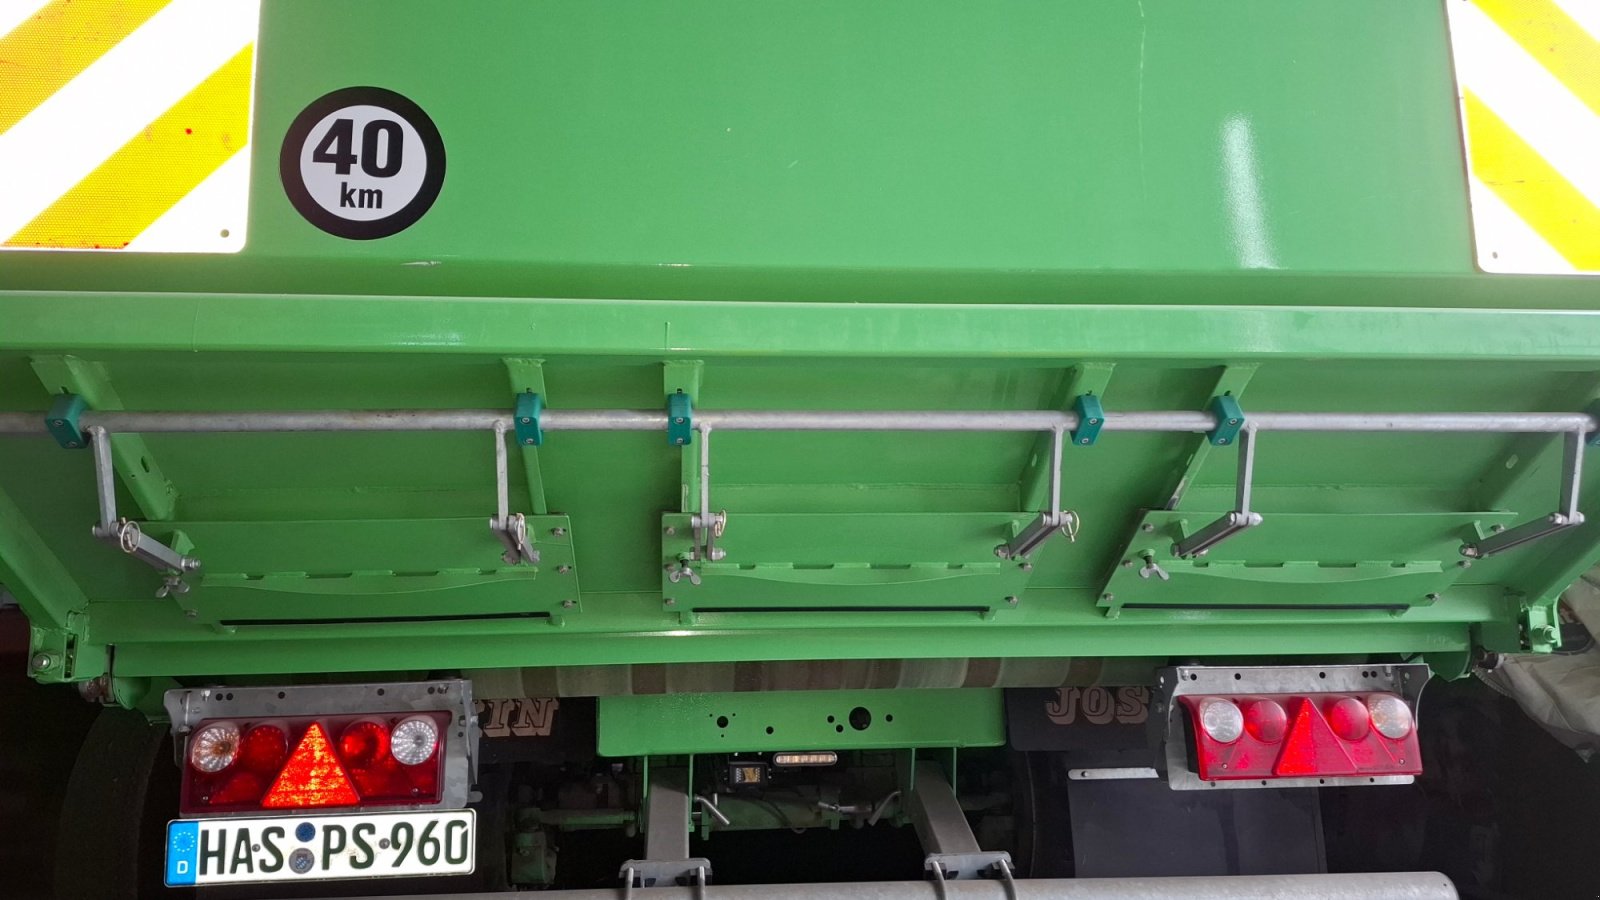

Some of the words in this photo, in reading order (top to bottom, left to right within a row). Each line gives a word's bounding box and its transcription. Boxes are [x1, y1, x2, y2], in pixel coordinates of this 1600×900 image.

[312, 118, 404, 178] 40
[340, 182, 383, 209] km
[176, 860, 188, 874] D
[198, 825, 285, 876] HAS
[321, 822, 376, 871] PS
[390, 819, 469, 868] 960
